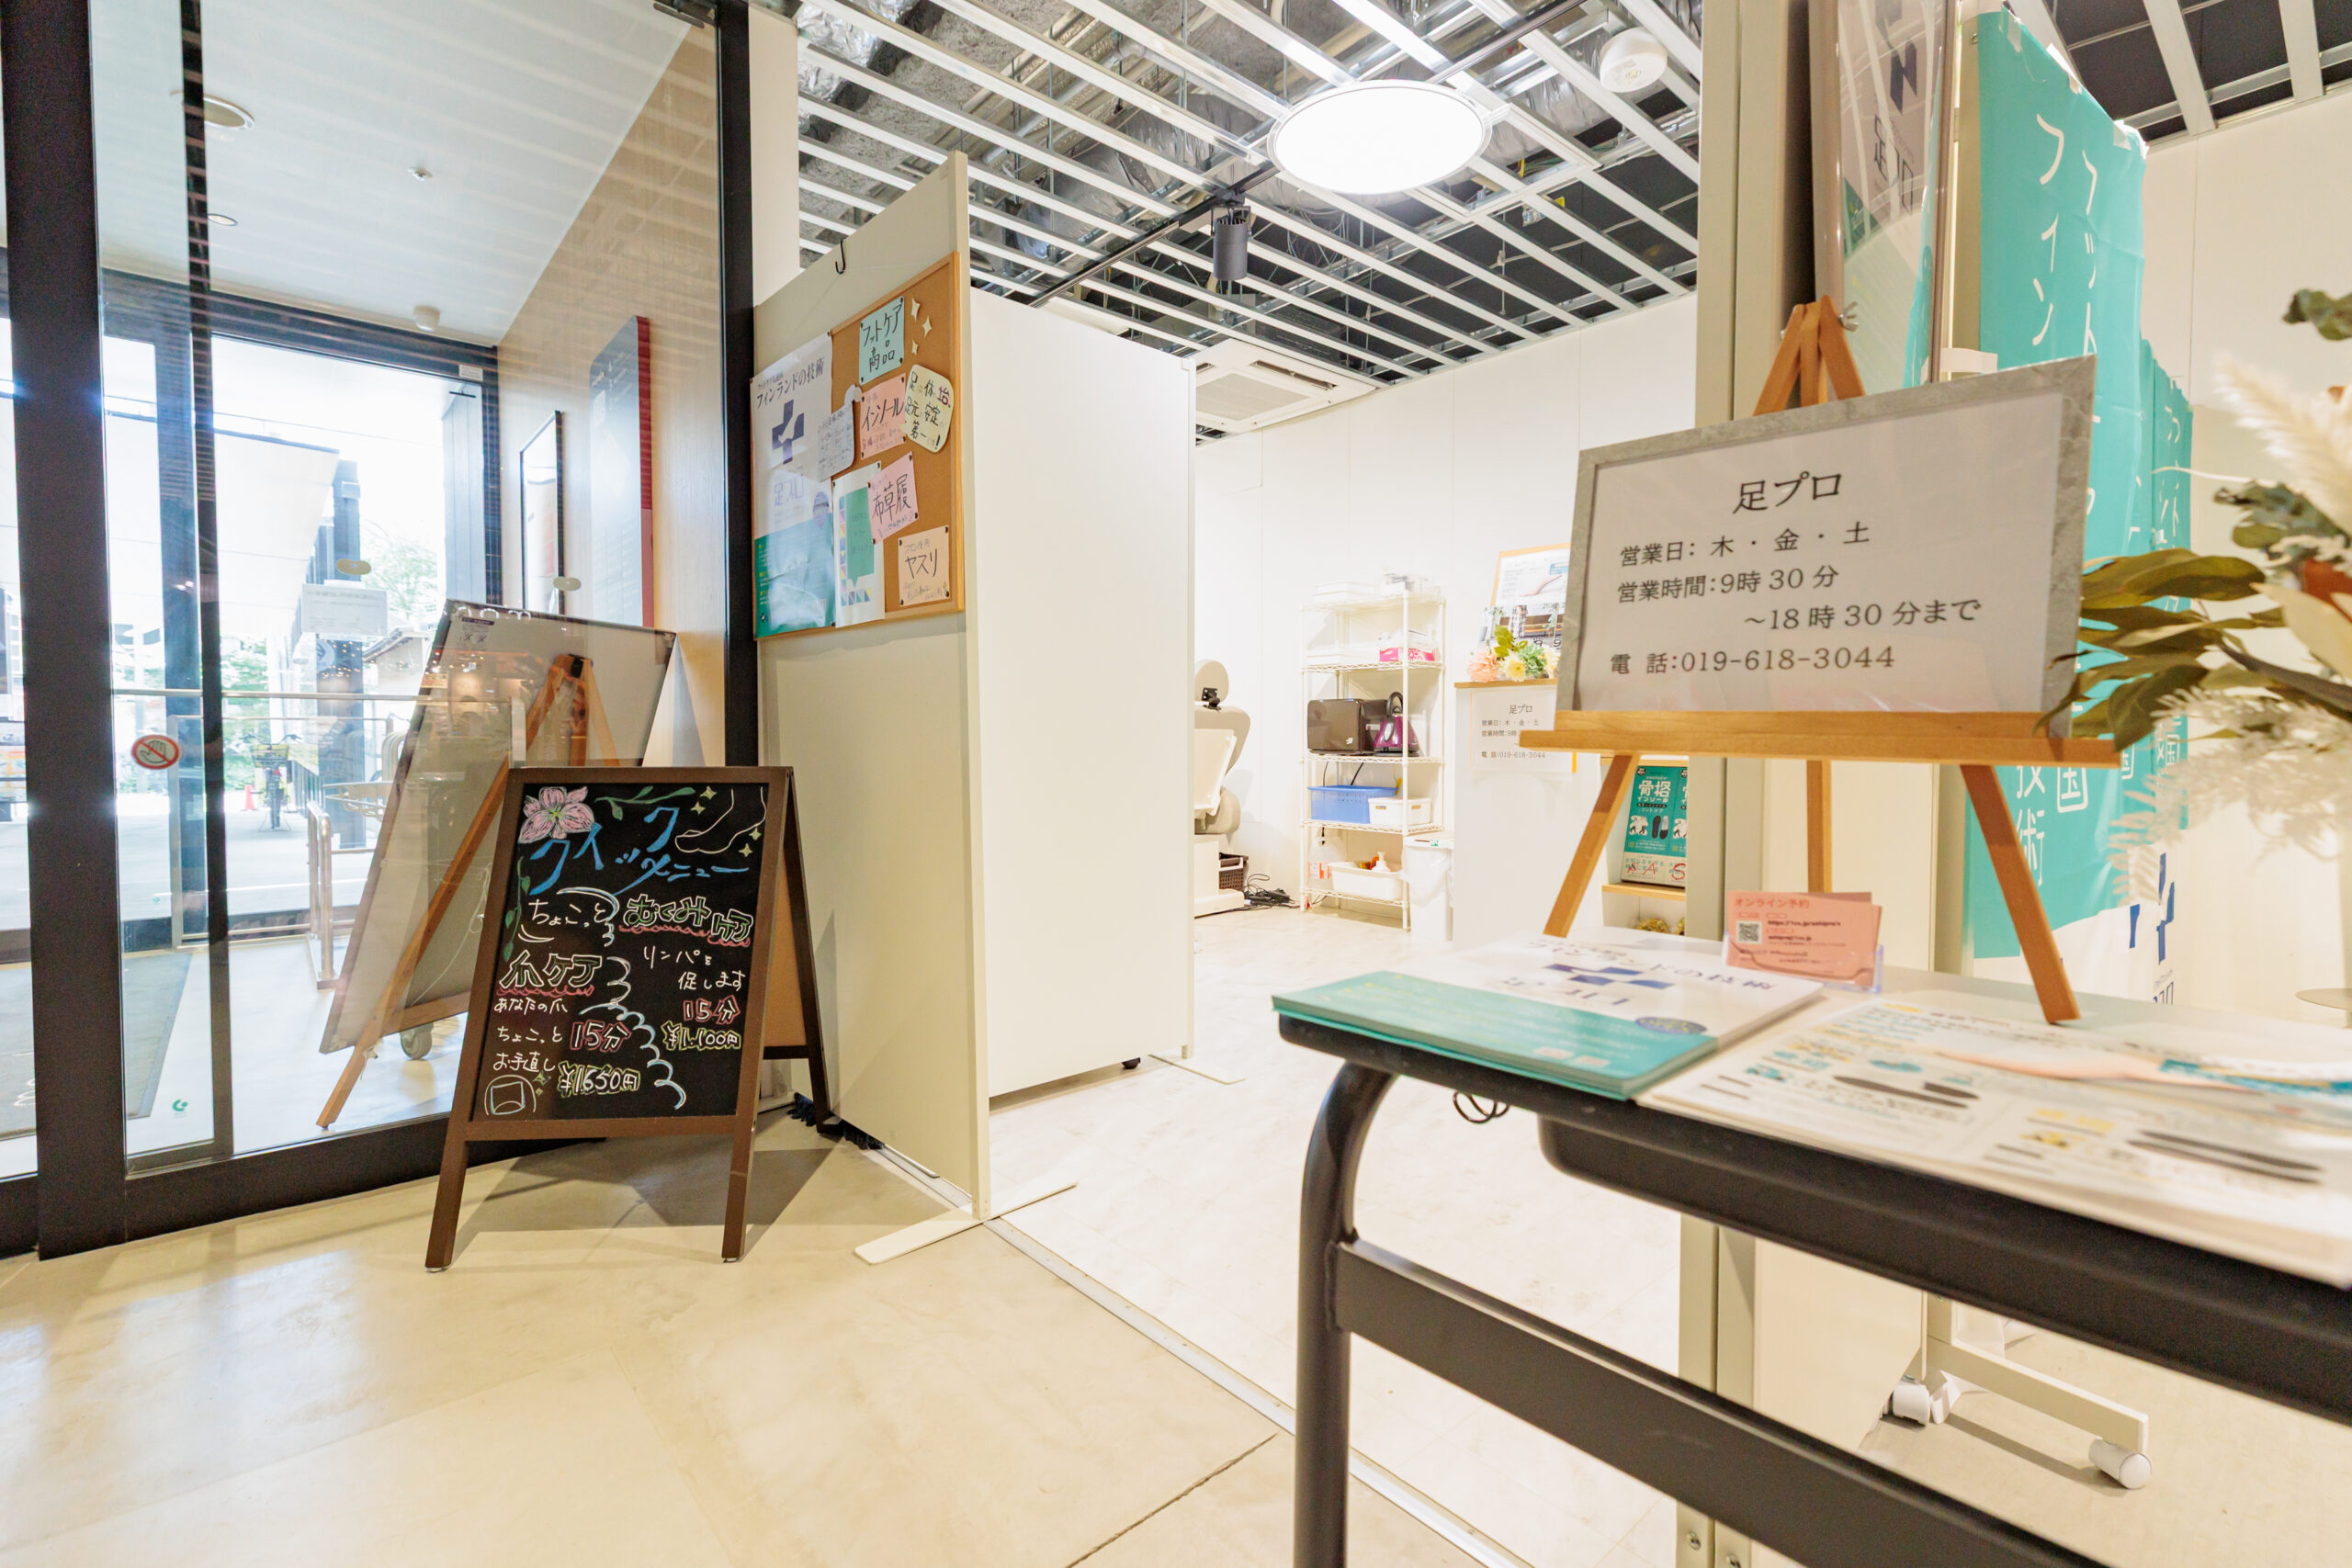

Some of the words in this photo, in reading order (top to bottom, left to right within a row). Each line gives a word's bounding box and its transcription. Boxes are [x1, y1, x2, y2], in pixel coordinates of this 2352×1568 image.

[862, 302, 904, 347] フットケア
[868, 339, 896, 373] 商品
[756, 356, 825, 411] フィンランドの技術
[861, 396, 905, 433] インソール
[872, 472, 912, 525] 布草履
[1733, 470, 1843, 514] 足プロ
[904, 547, 938, 580] ヤスリ
[527, 898, 611, 929] ちょこっと
[642, 945, 713, 969] リンパを
[677, 968, 747, 993] 促します
[683, 996, 741, 1025] 15分
[496, 1025, 563, 1044] ちょこっと
[570, 1020, 633, 1052] 15分
[492, 1051, 557, 1073] お手直し
